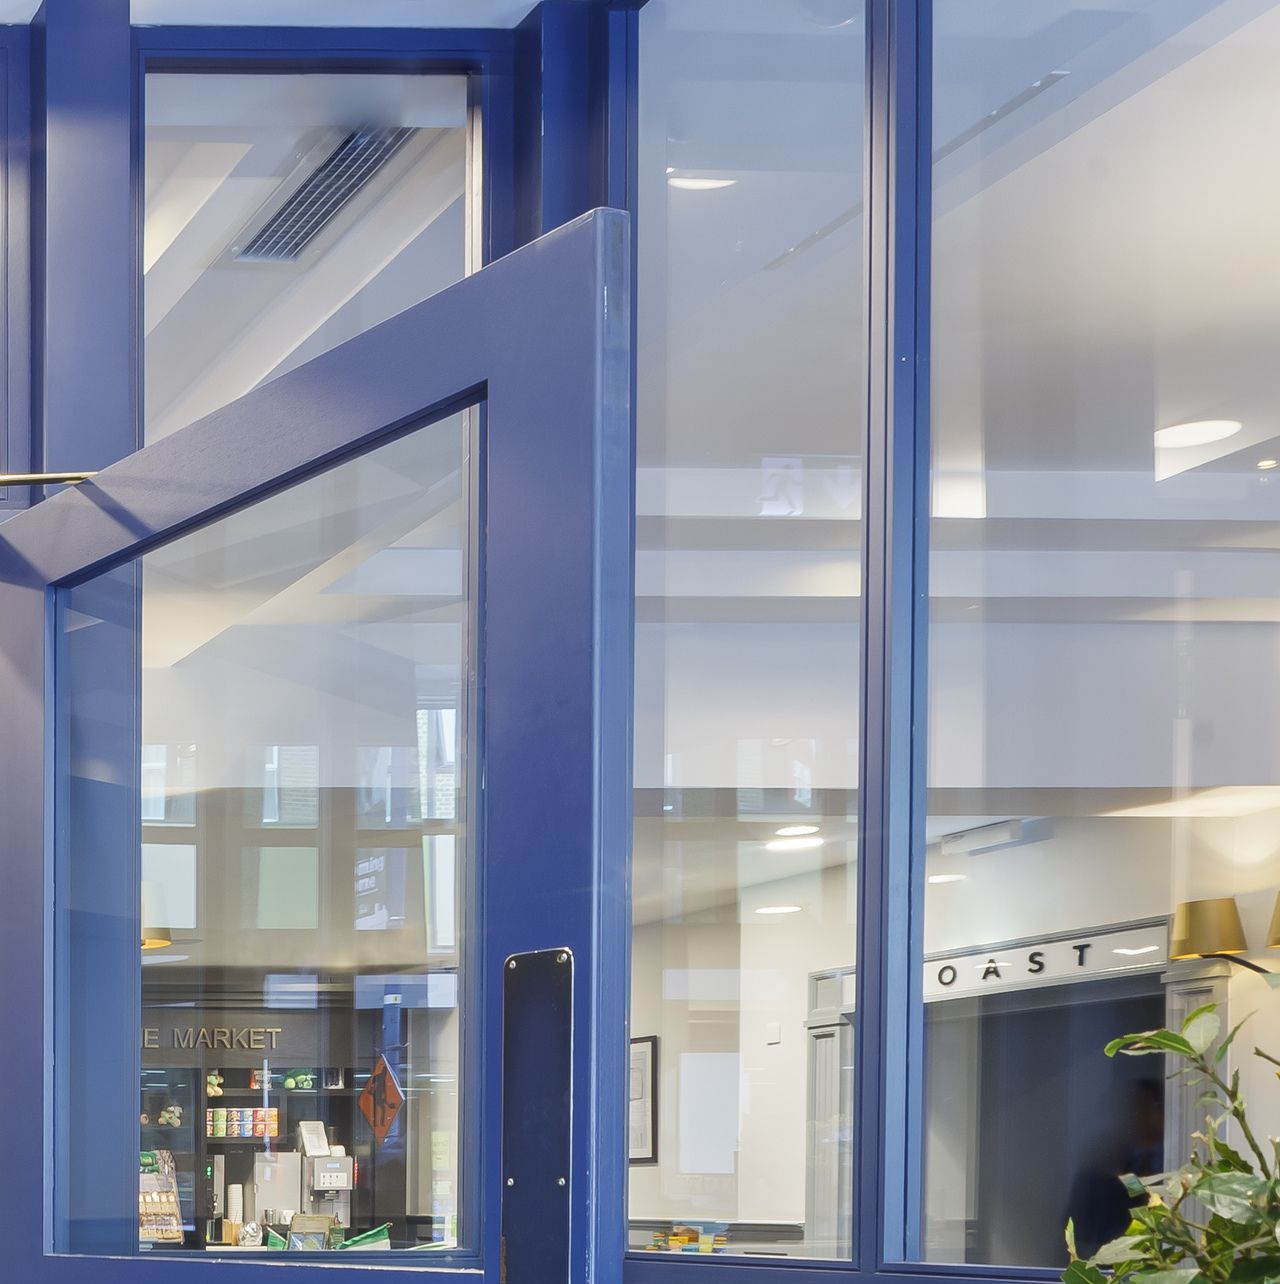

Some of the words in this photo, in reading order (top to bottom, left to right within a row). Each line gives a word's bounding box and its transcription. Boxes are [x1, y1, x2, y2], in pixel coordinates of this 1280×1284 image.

[937, 943, 1092, 986] OAST
[142, 1027, 160, 1049] E
[173, 1027, 282, 1049] MARKET
